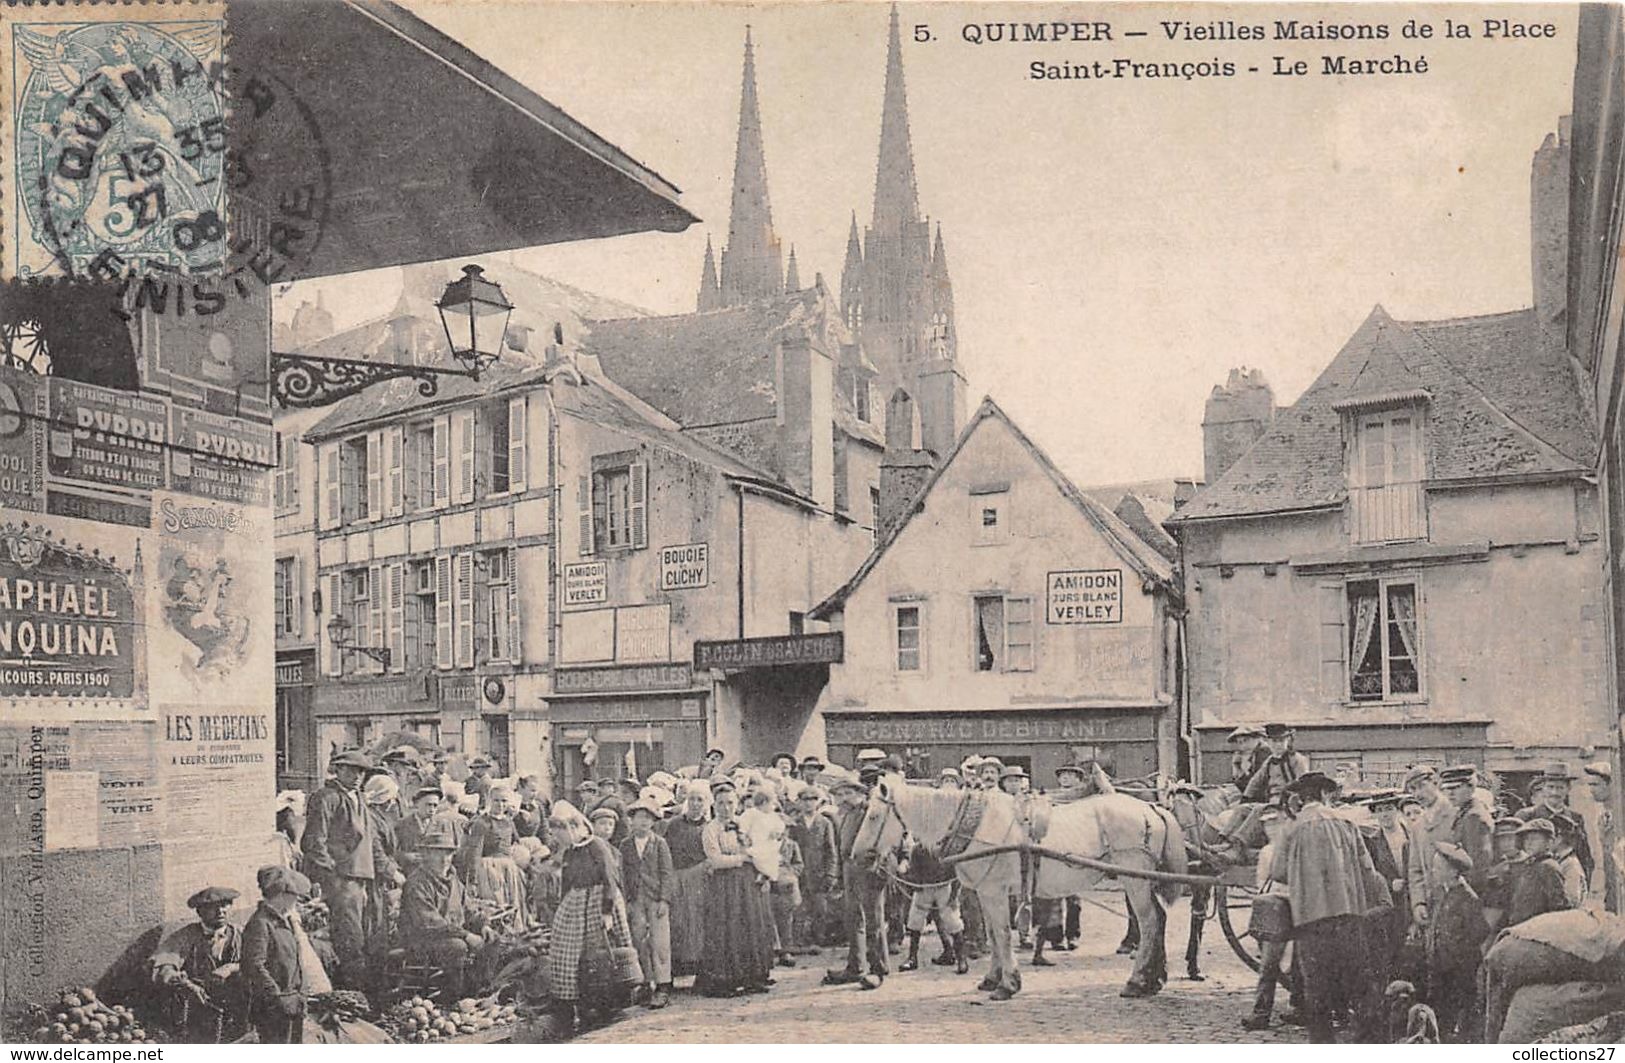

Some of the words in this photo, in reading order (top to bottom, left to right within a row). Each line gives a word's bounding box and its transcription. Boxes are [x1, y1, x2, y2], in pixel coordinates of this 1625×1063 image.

[664, 547, 705, 564] BOUGIE
[568, 565, 604, 578] AMIDON
[666, 568, 704, 585] CLICHY
[1053, 575, 1117, 590] AMIDON
[569, 589, 602, 600] VERLEY
[1083, 592, 1118, 602] BLANC
[1055, 604, 1113, 619] VERLEY
[767, 638, 834, 660] GRAVEUR
[84, 673, 110, 687] 1900
[166, 715, 193, 741] LES
[180, 755, 207, 765] LEURS
[100, 781, 145, 790] VENTE
[107, 804, 154, 814] VENTE
